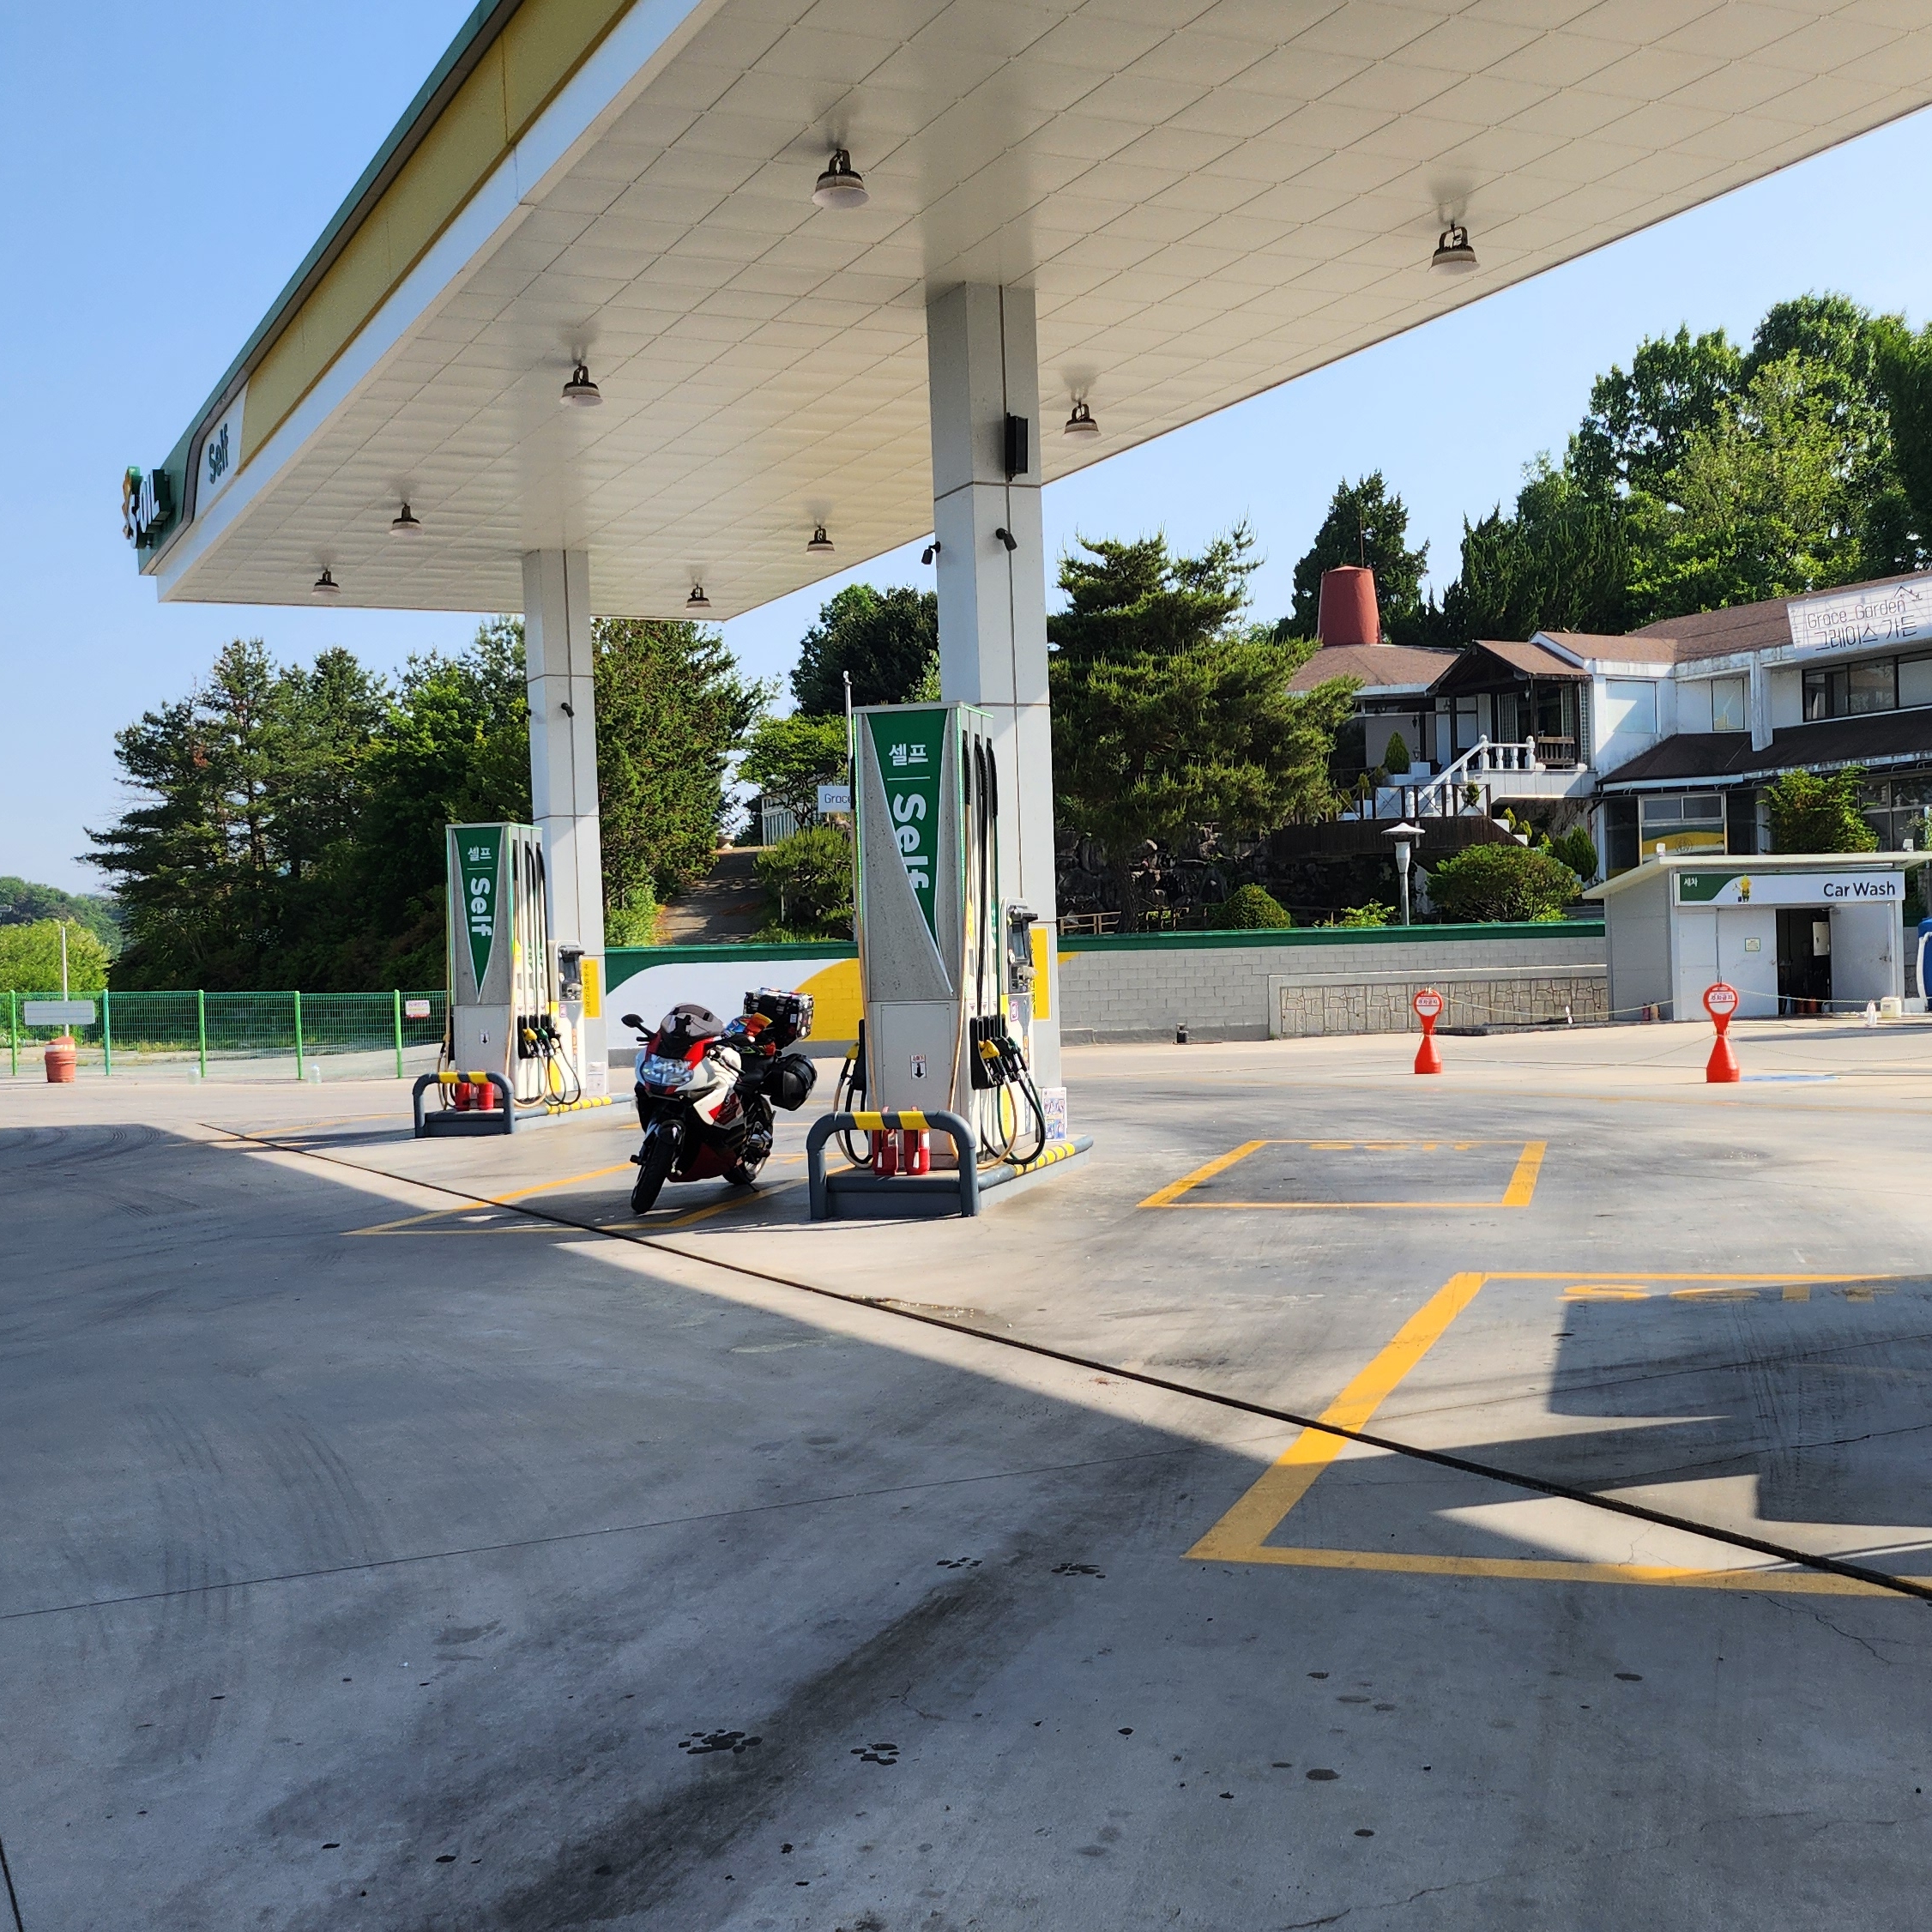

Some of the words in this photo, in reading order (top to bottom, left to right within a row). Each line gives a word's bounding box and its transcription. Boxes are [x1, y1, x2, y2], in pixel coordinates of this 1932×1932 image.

[208, 422, 229, 485] Self
[1807, 609, 1847, 629] Grace
[1855, 600, 1906, 620] Garden
[1814, 623, 1878, 651] 그레이스
[1882, 614, 1918, 640] 가든
[888, 742, 929, 766] 셀프
[467, 845, 492, 861] 셀프
[891, 793, 929, 890] Self
[1683, 876, 1699, 887] 세차
[1823, 882, 1850, 897] Car
[1853, 880, 1896, 897] Wash
[470, 877, 492, 938] Self
